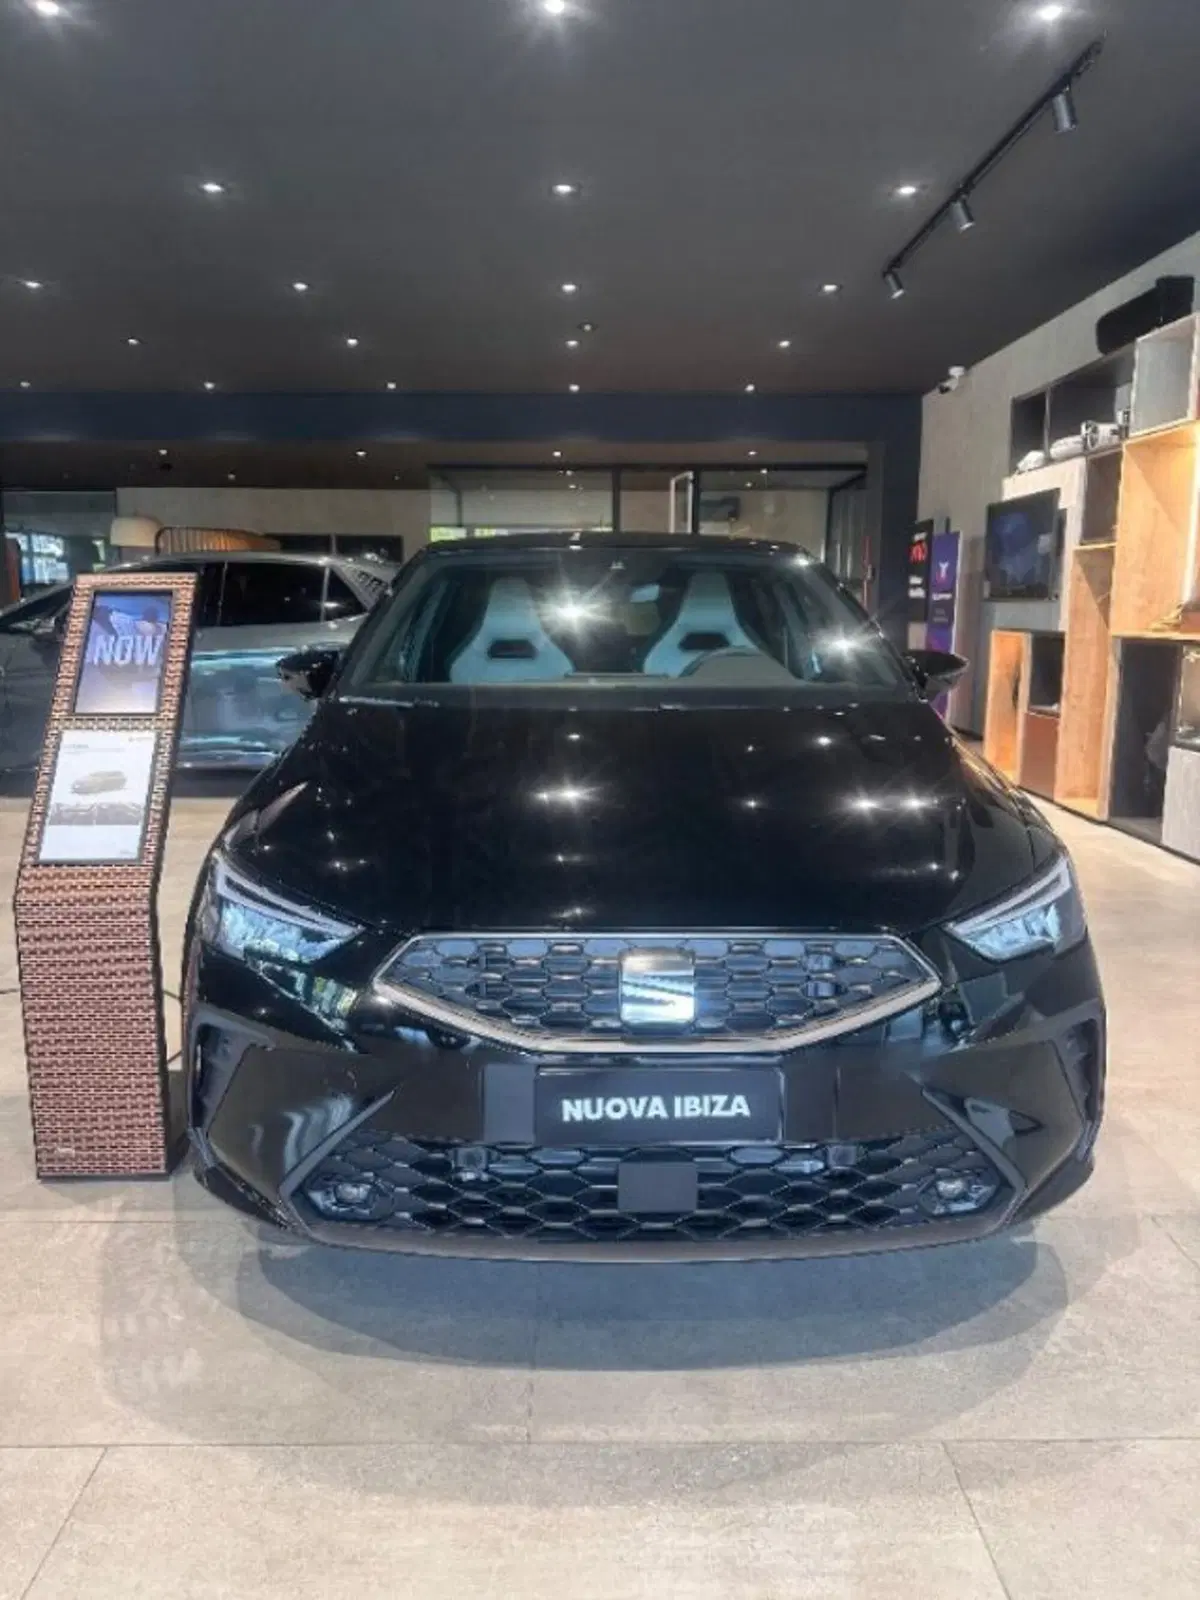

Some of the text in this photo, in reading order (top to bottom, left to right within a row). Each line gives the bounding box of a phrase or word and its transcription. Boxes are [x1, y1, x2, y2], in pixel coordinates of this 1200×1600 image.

[93, 634, 164, 666] NOW
[562, 1094, 751, 1122] NUOVA IBIZA
